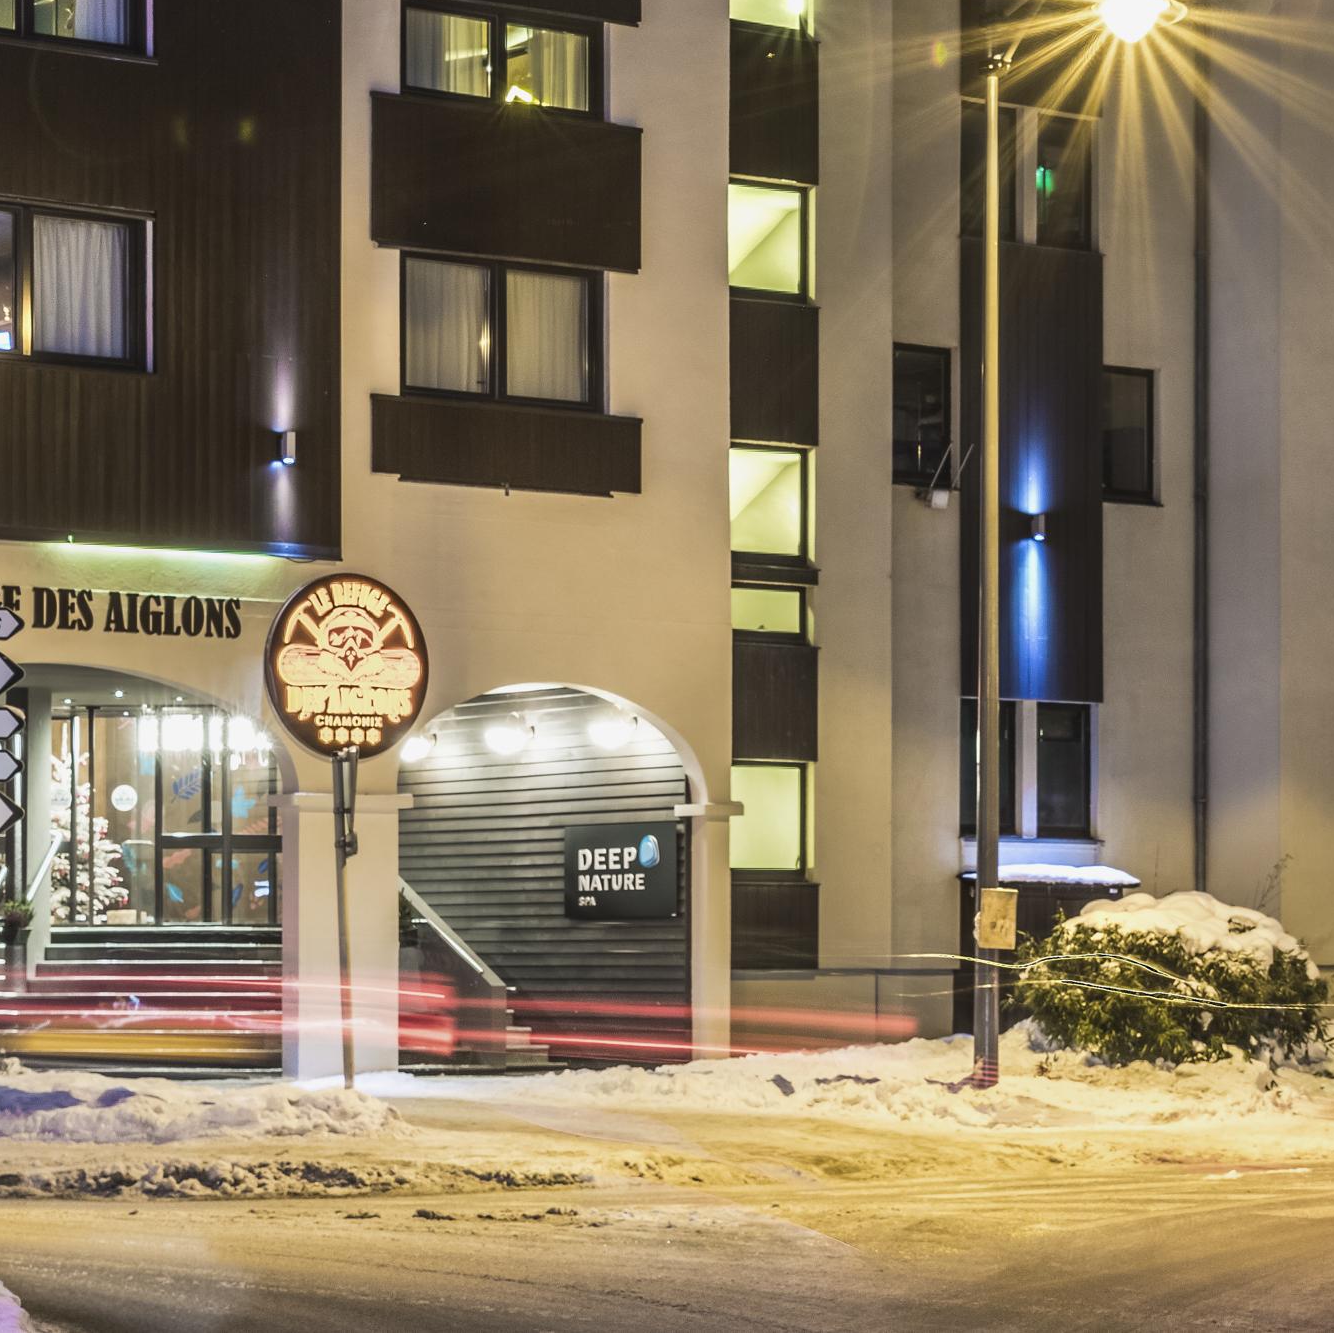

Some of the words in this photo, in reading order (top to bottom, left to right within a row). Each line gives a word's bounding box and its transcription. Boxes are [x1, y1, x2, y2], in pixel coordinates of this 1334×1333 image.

[308, 587, 334, 616] LE
[330, 581, 391, 618] REFUGE
[31, 586, 94, 631] DES
[103, 591, 242, 639] AIGLONS
[315, 715, 383, 728] CHAMONIX
[578, 847, 637, 871] DEEP
[578, 873, 645, 892] NATURE
[578, 896, 596, 906] SPA
